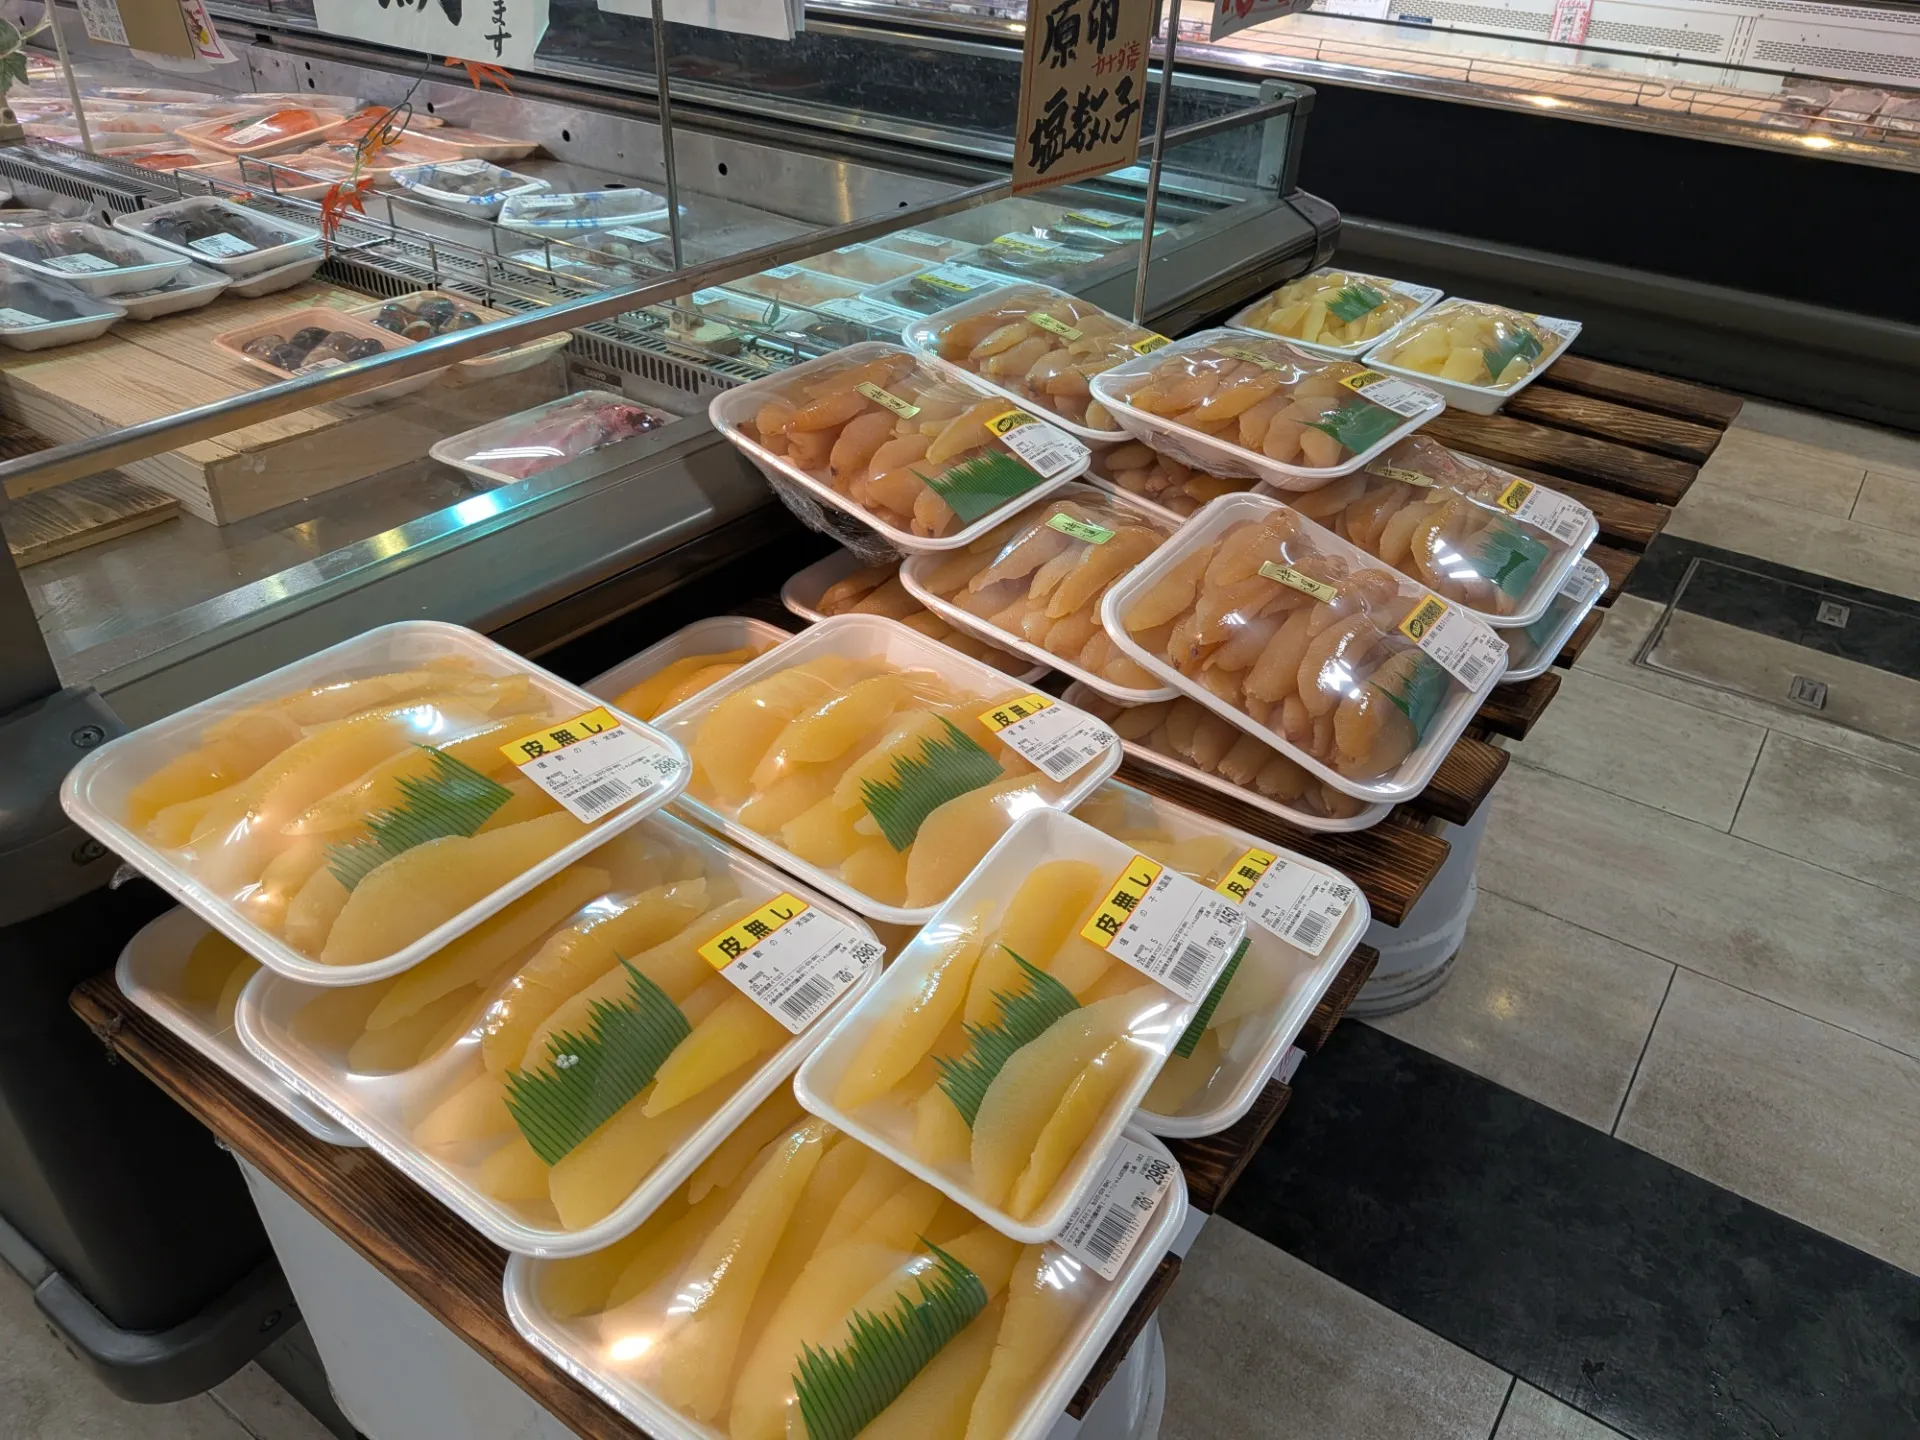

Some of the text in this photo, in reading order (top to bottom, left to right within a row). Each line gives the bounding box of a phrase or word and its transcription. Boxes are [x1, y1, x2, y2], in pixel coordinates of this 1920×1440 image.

[992, 702, 1044, 727] 皮無し
[520, 723, 603, 760] 皮無し
[652, 758, 680, 774] 2980
[1227, 858, 1273, 898] 皮無し
[1096, 874, 1152, 936] 皮無し
[1218, 907, 1239, 927] 1450
[718, 909, 793, 959] 皮無し
[737, 928, 792, 970] 塩数の子
[837, 944, 878, 983] 400 2980
[1138, 1160, 1170, 1211] 400 2980
